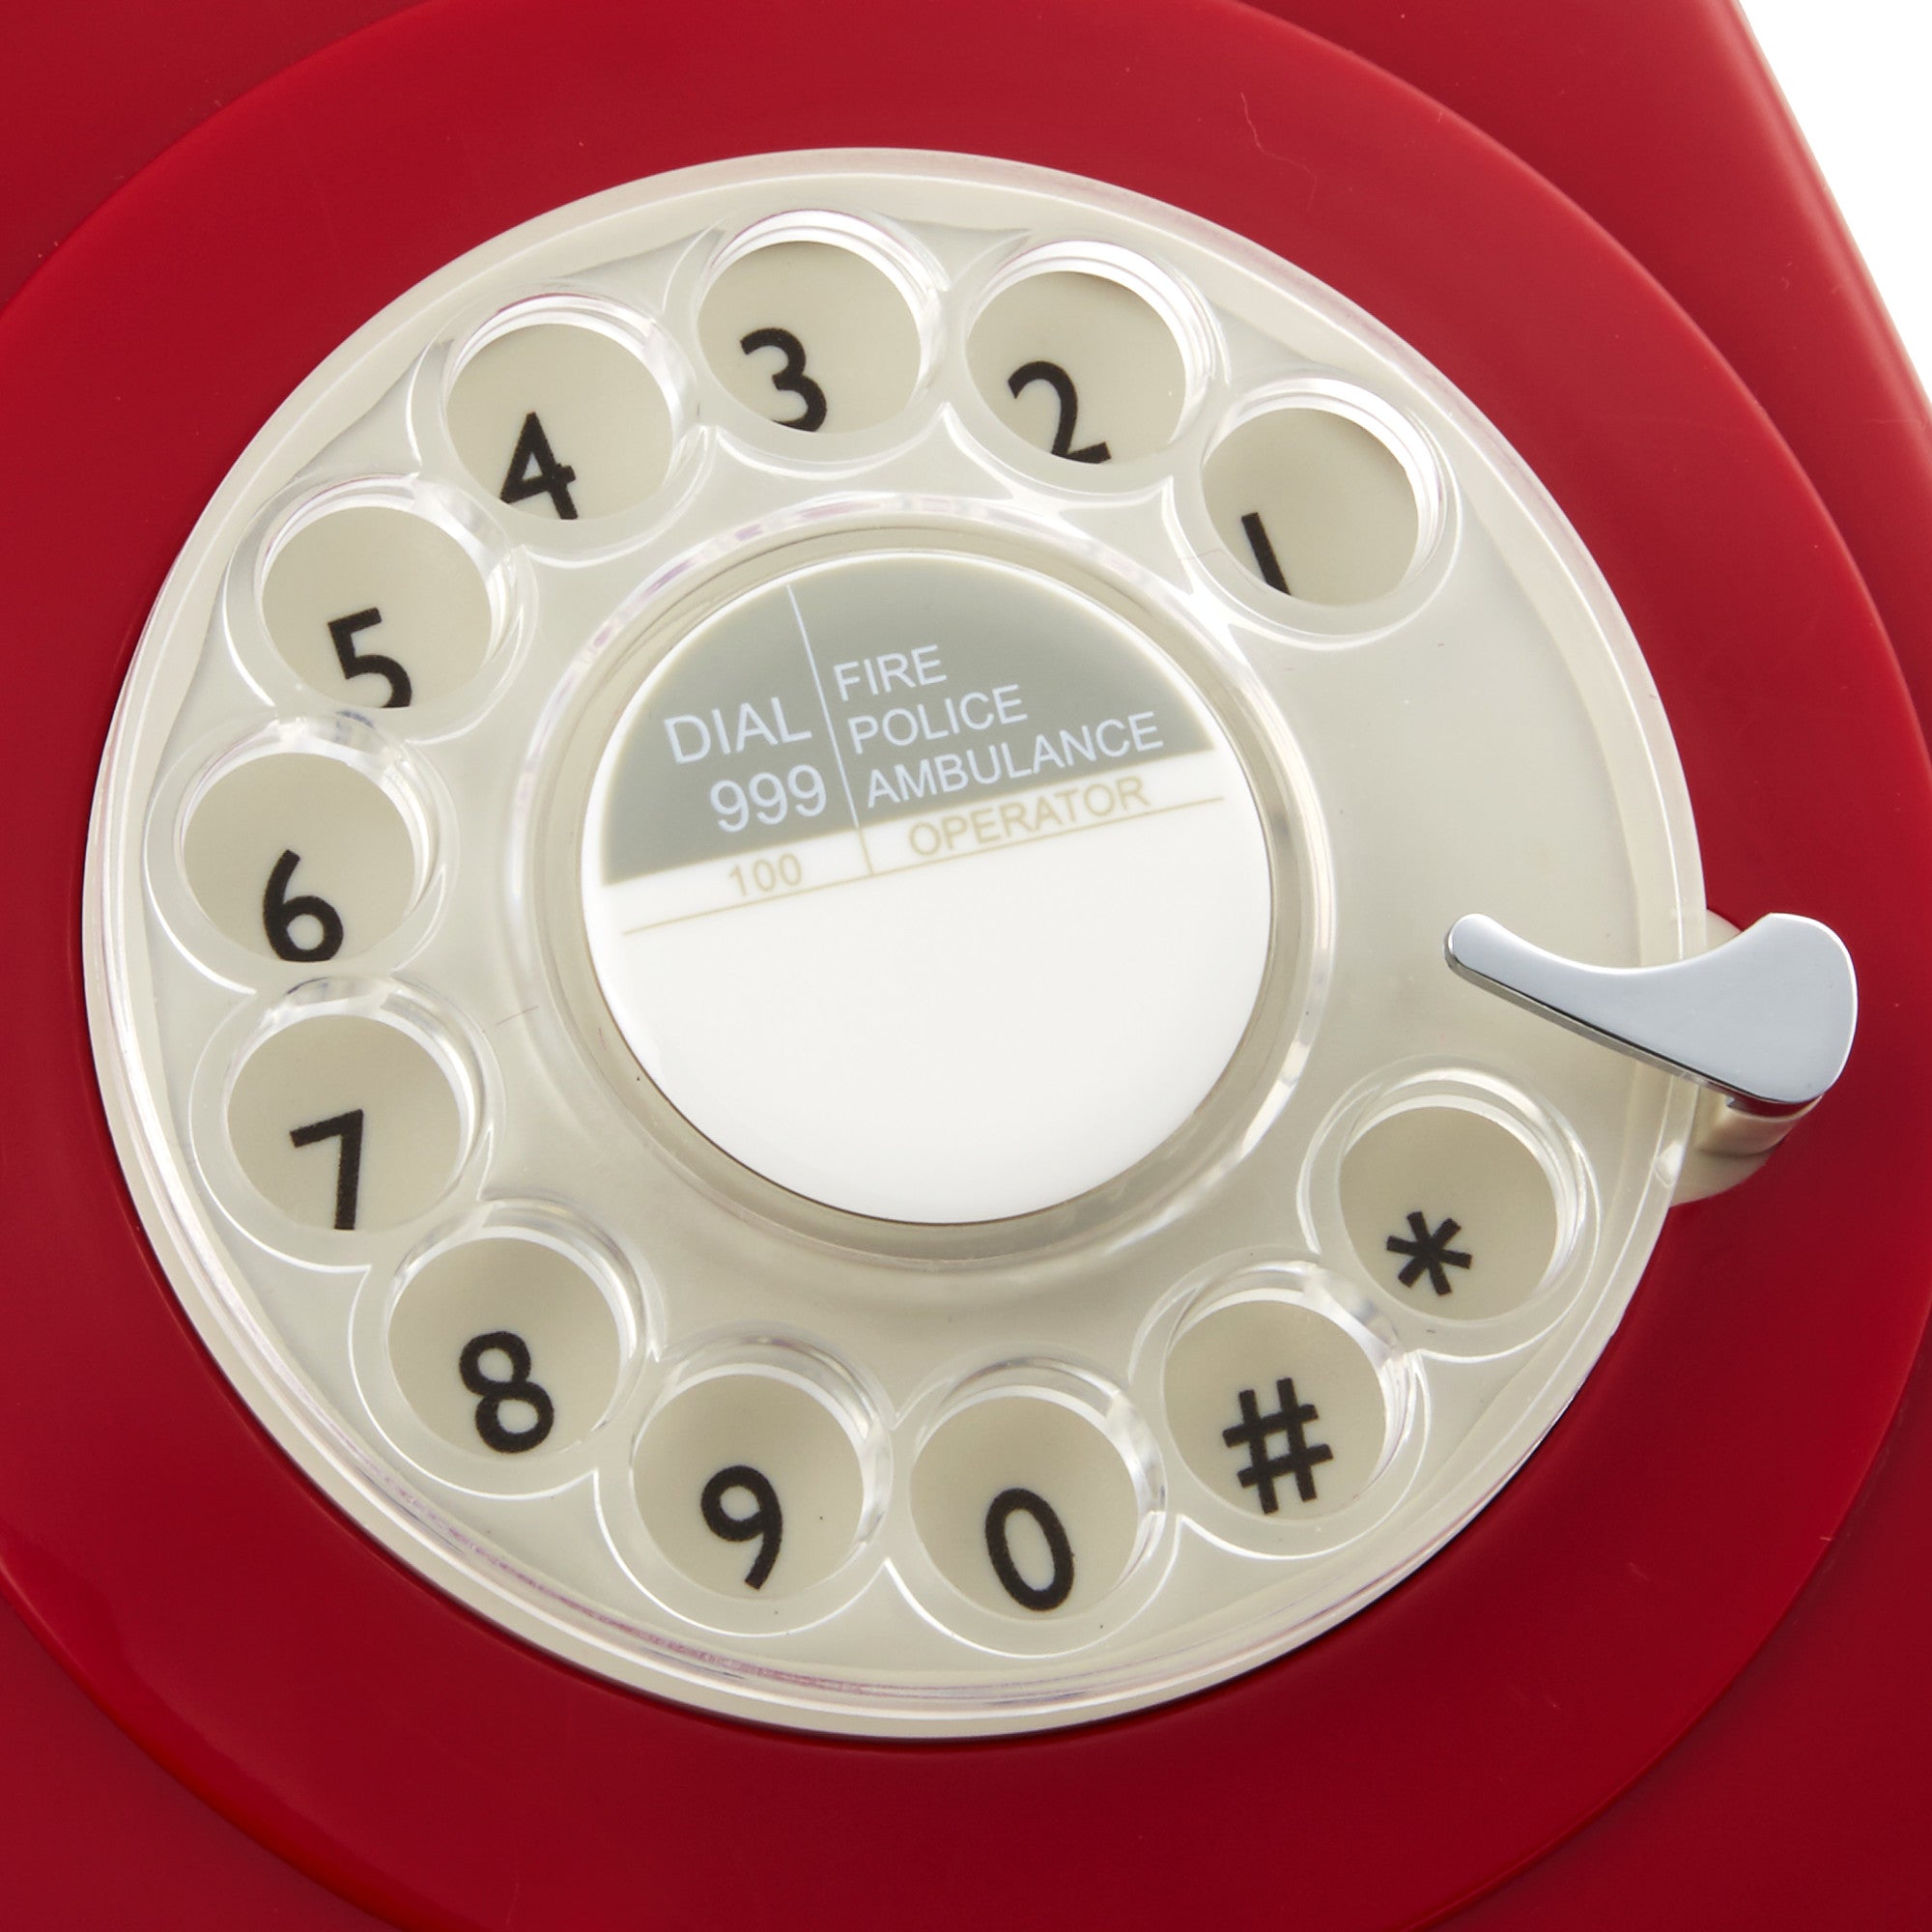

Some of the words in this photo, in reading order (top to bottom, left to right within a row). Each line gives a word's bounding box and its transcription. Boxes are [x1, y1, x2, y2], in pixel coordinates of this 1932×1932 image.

[741, 327, 828, 433] 3
[1008, 360, 1111, 465] 2
[499, 412, 579, 521] 4
[1241, 512, 1292, 595] 1
[327, 608, 412, 708] 5
[834, 644, 948, 700] FIRE
[664, 696, 811, 763] DIAL
[847, 684, 1028, 754] POLICE
[867, 711, 1164, 809] AMBULANCE
[709, 763, 828, 832] 999
[728, 853, 803, 897] 100
[908, 775, 1151, 858] OPERATOR
[263, 849, 344, 963] 6
[289, 1109, 364, 1231] 7
[458, 1330, 554, 1454] 8
[699, 1464, 783, 1590] 9
[984, 1488, 1074, 1612] 0
